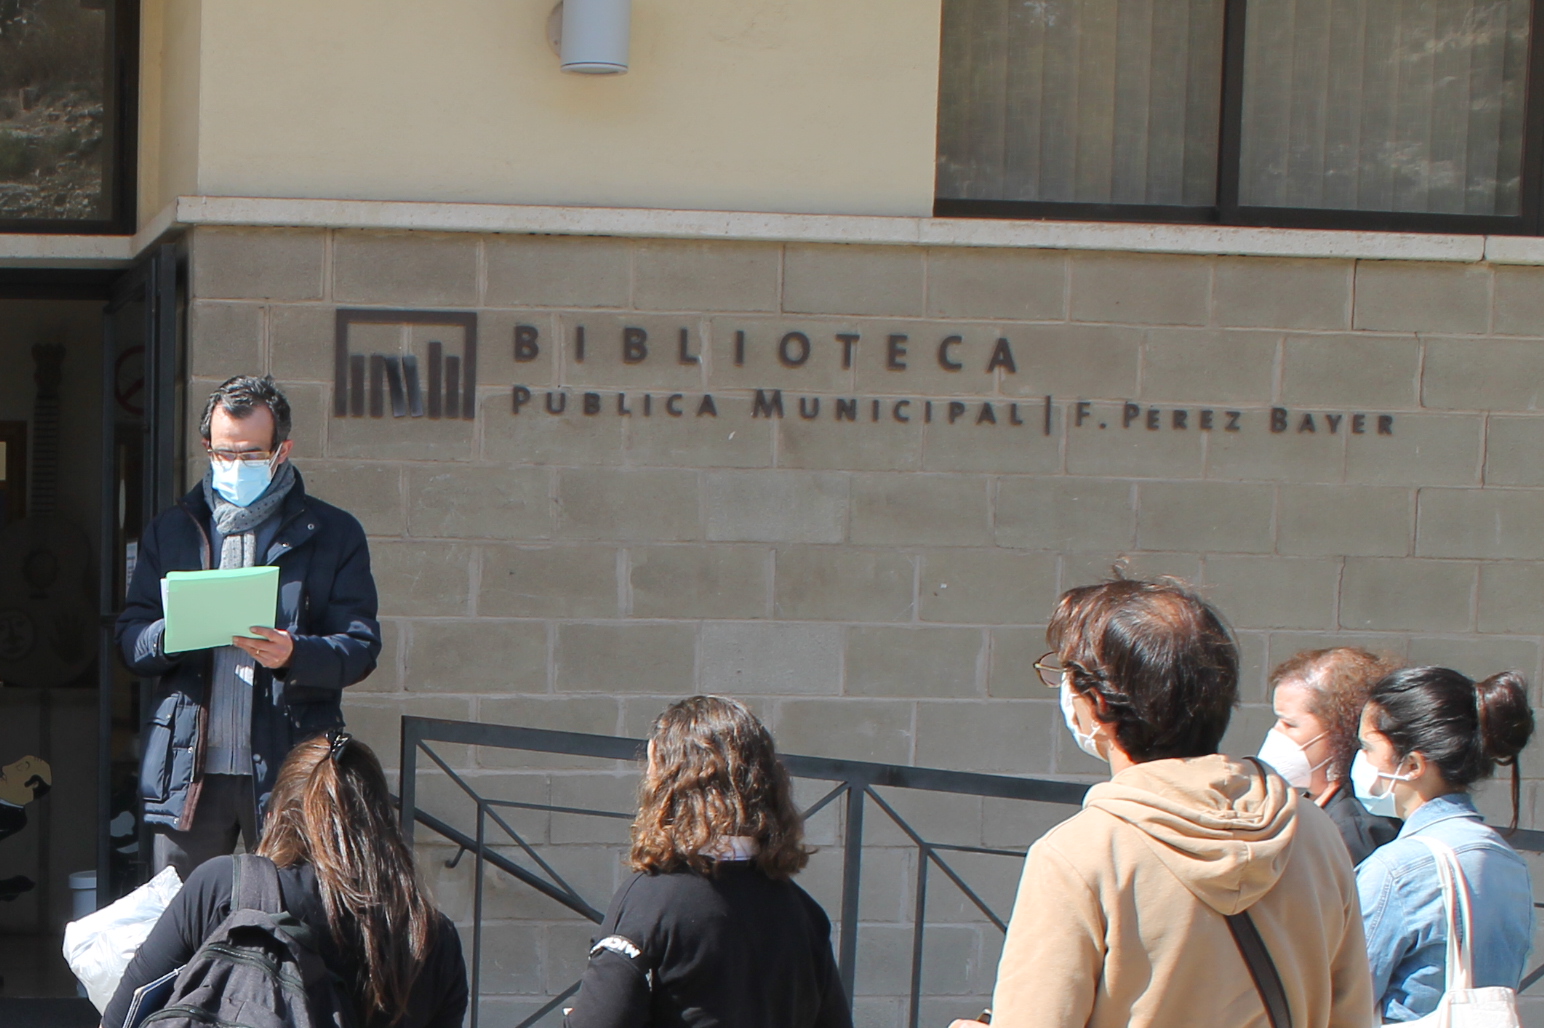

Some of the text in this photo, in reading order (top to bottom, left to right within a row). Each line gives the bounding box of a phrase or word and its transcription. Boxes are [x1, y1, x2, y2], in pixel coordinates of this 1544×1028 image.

[514, 325, 1017, 375] BIBLIOTECA
[512, 385, 1396, 436] PUBLICA MUNICIPAL F. PEREZ BAYER
